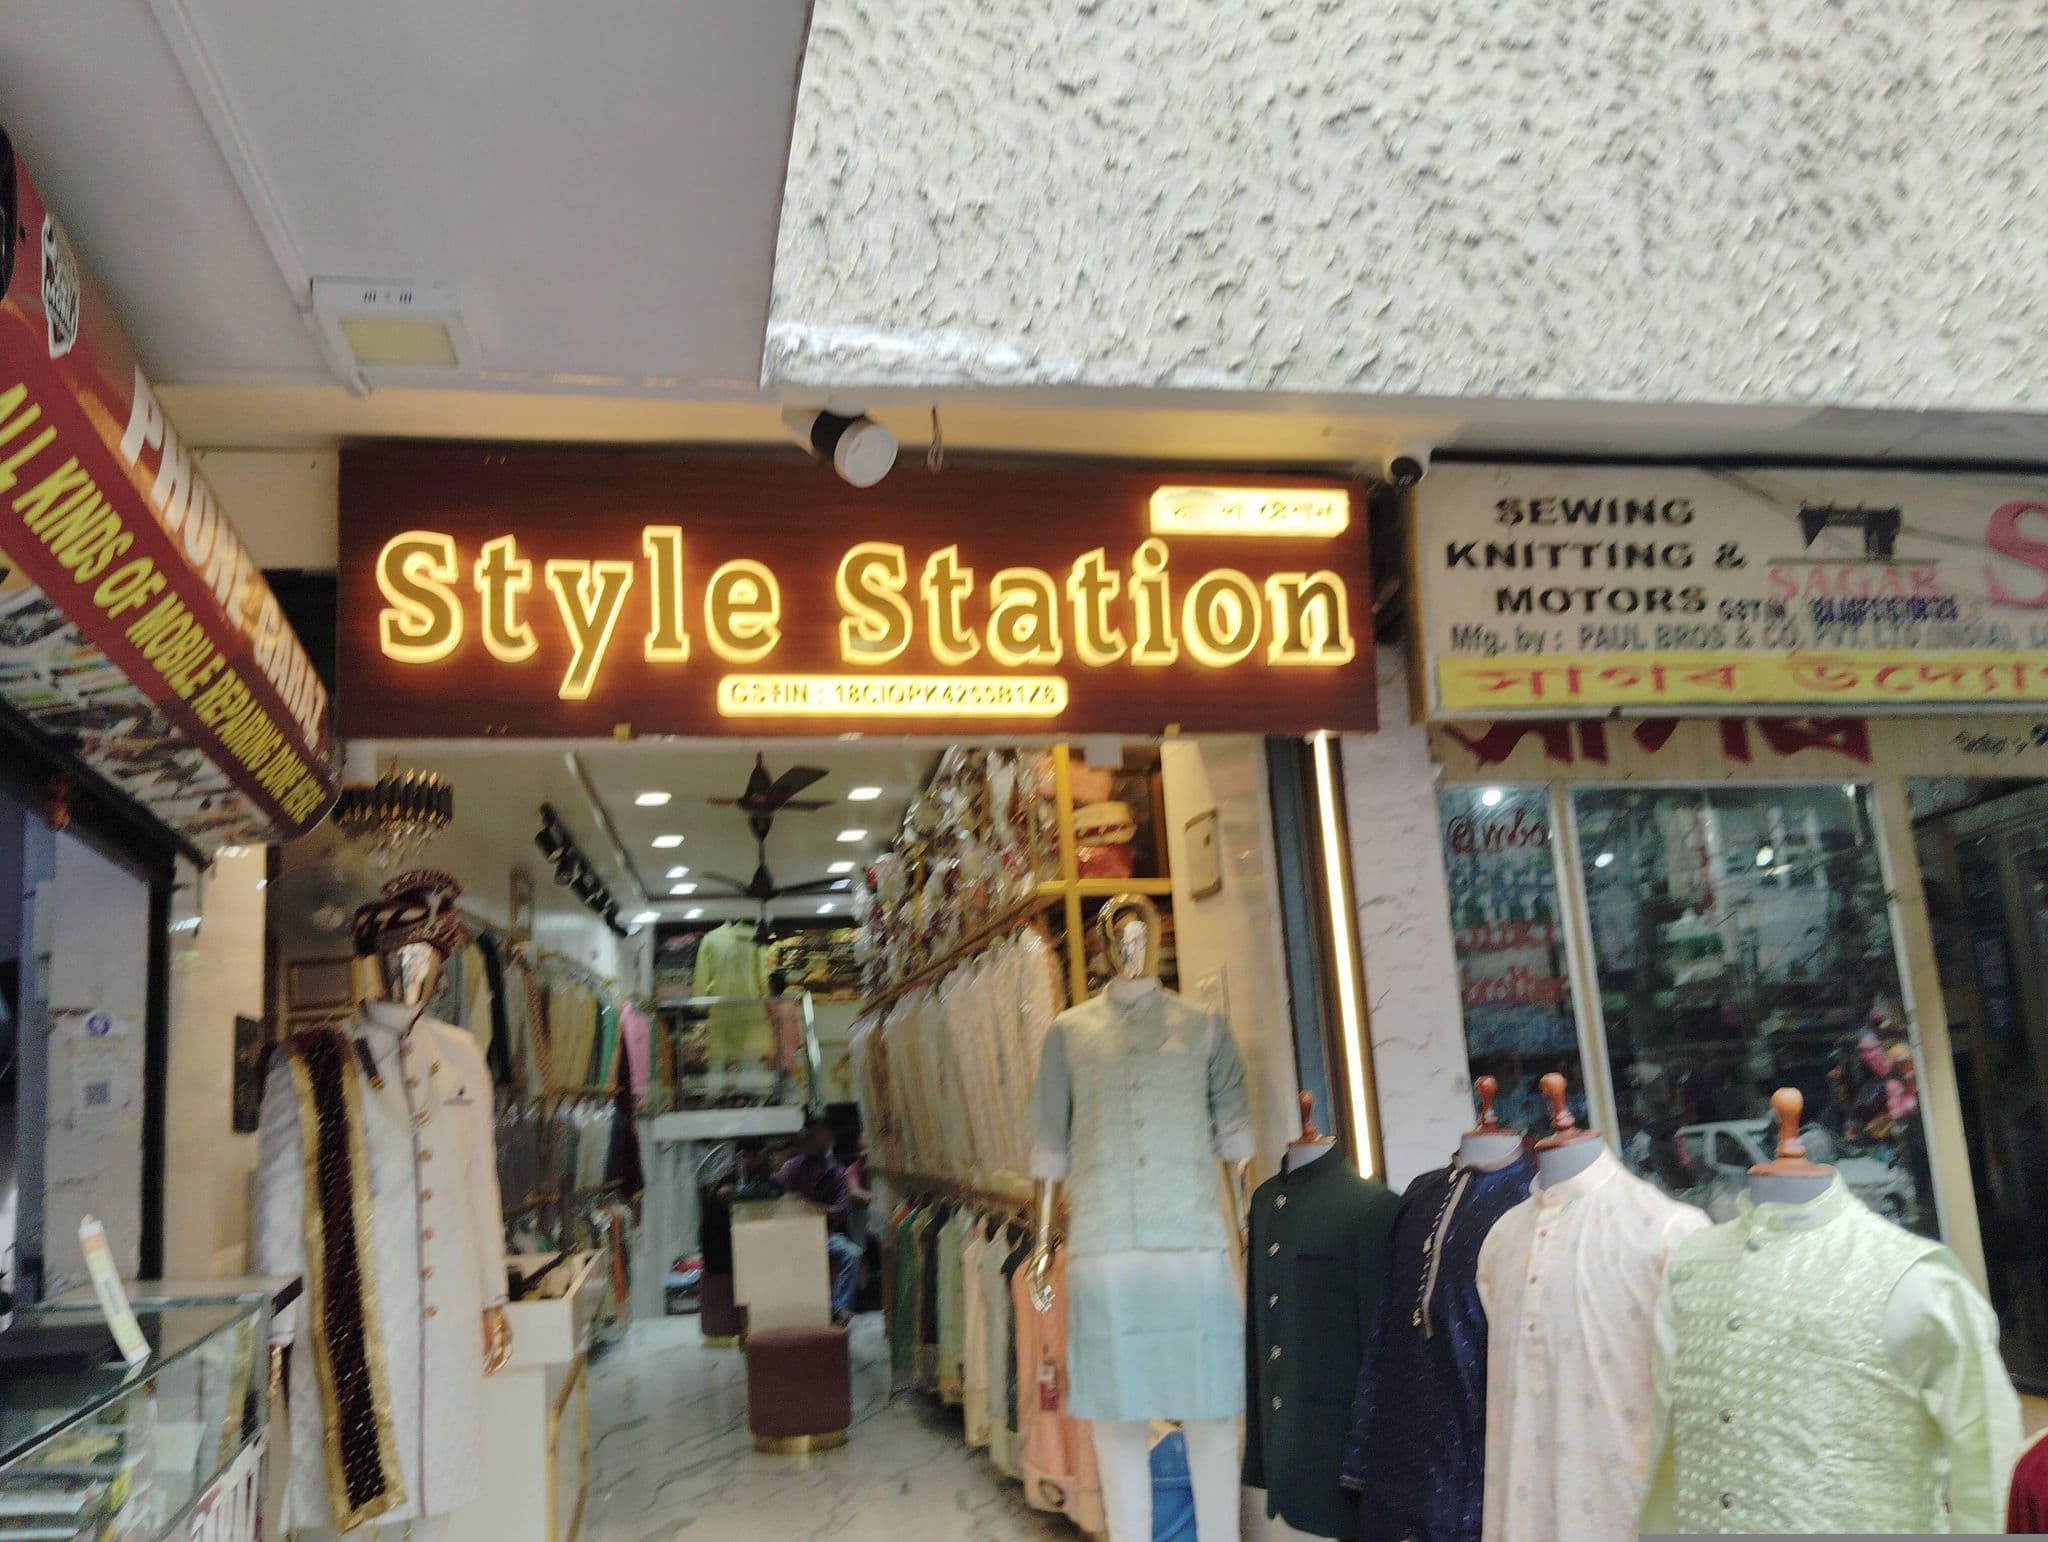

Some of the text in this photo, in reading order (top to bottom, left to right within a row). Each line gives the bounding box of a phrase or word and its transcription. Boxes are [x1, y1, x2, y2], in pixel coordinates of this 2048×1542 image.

[11, 455, 135, 585] KINDS
[120, 365, 257, 631] PHONE
[1495, 496, 1695, 527] SEWING
[1445, 541, 1748, 571] KNITTING &
[1768, 564, 1942, 602] SAGAR
[93, 556, 168, 621] OF
[377, 524, 1358, 701] Style Station
[1495, 584, 1708, 615] MOTORS
[124, 591, 227, 701] MOBILE
[1579, 623, 1649, 650] PAUL
[189, 667, 285, 773] REPAIRING
[730, 681, 809, 706] GSTIN
[254, 741, 310, 806] DONE
[276, 772, 328, 826] HERE
